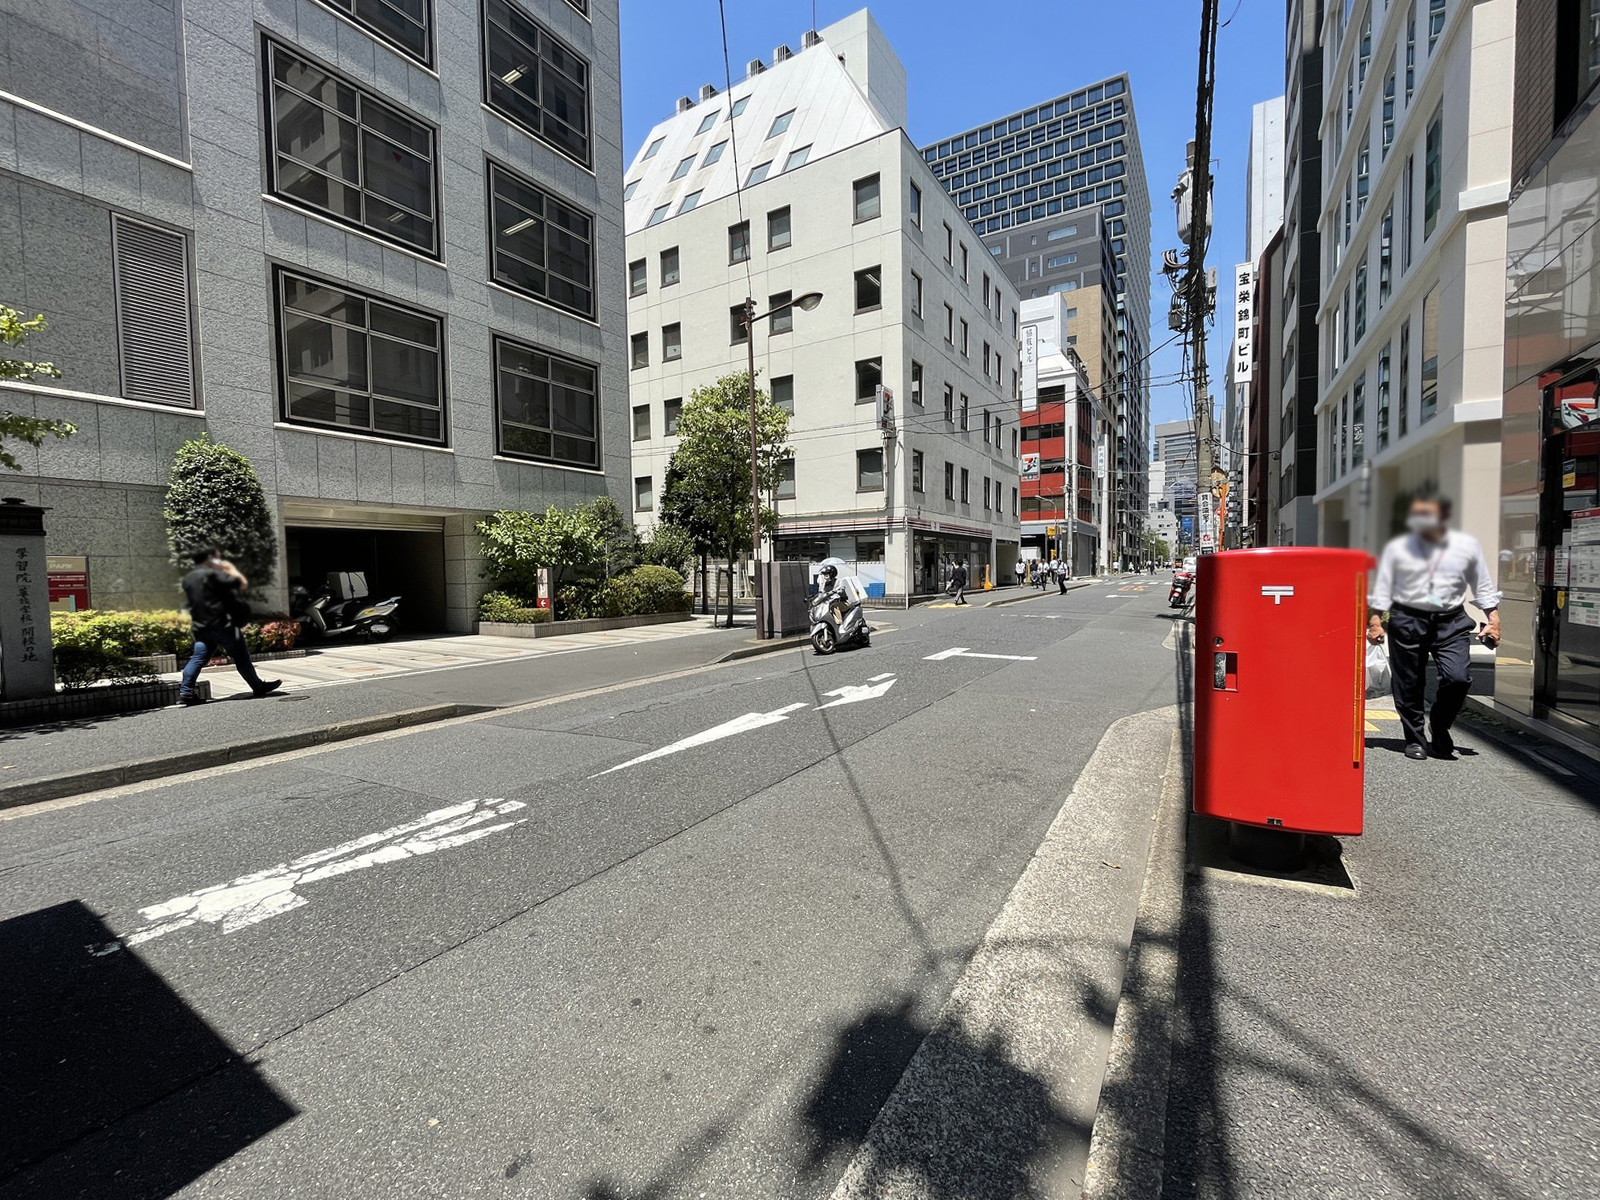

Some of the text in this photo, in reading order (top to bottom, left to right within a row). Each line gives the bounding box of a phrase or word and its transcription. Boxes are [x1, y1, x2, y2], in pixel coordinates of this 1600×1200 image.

[1237, 271, 1250, 373] 宝栄錦町ビル
